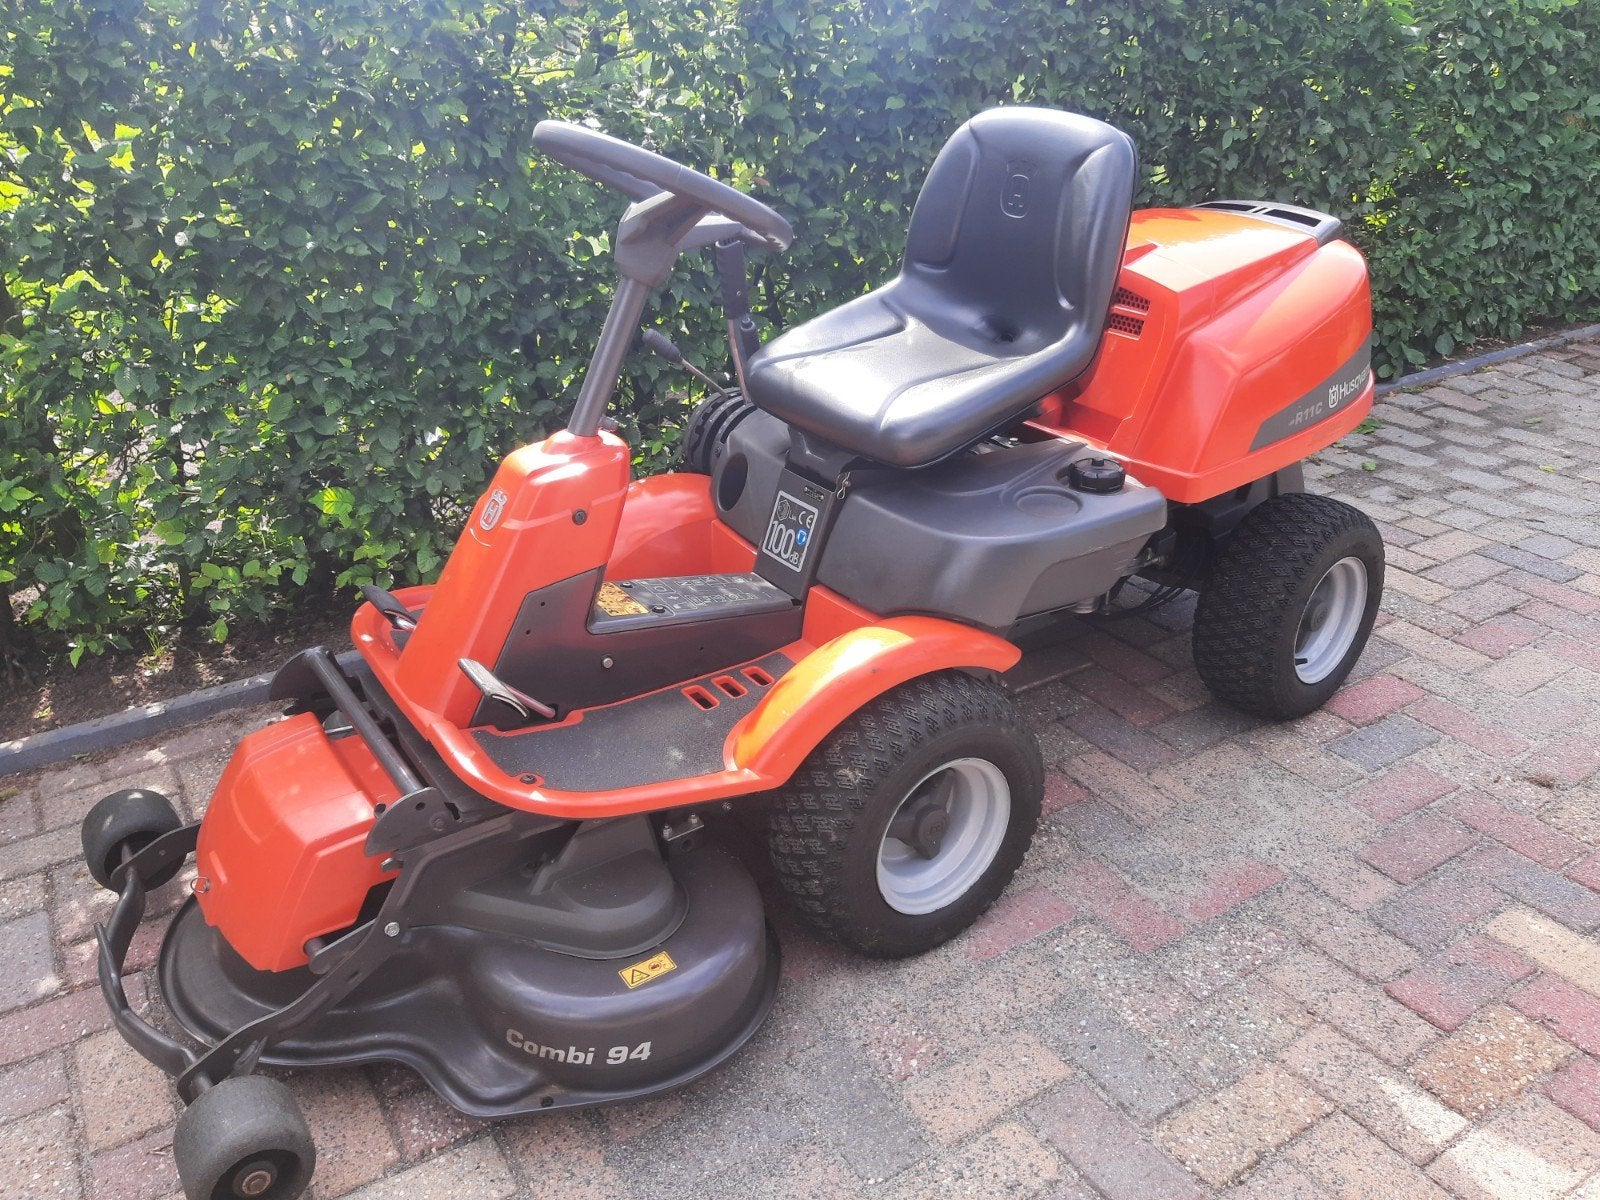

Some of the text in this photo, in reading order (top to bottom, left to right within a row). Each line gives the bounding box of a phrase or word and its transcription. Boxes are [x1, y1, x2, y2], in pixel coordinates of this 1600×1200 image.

[768, 521, 795, 559] 100
[506, 1028, 651, 1065] Combi 94
